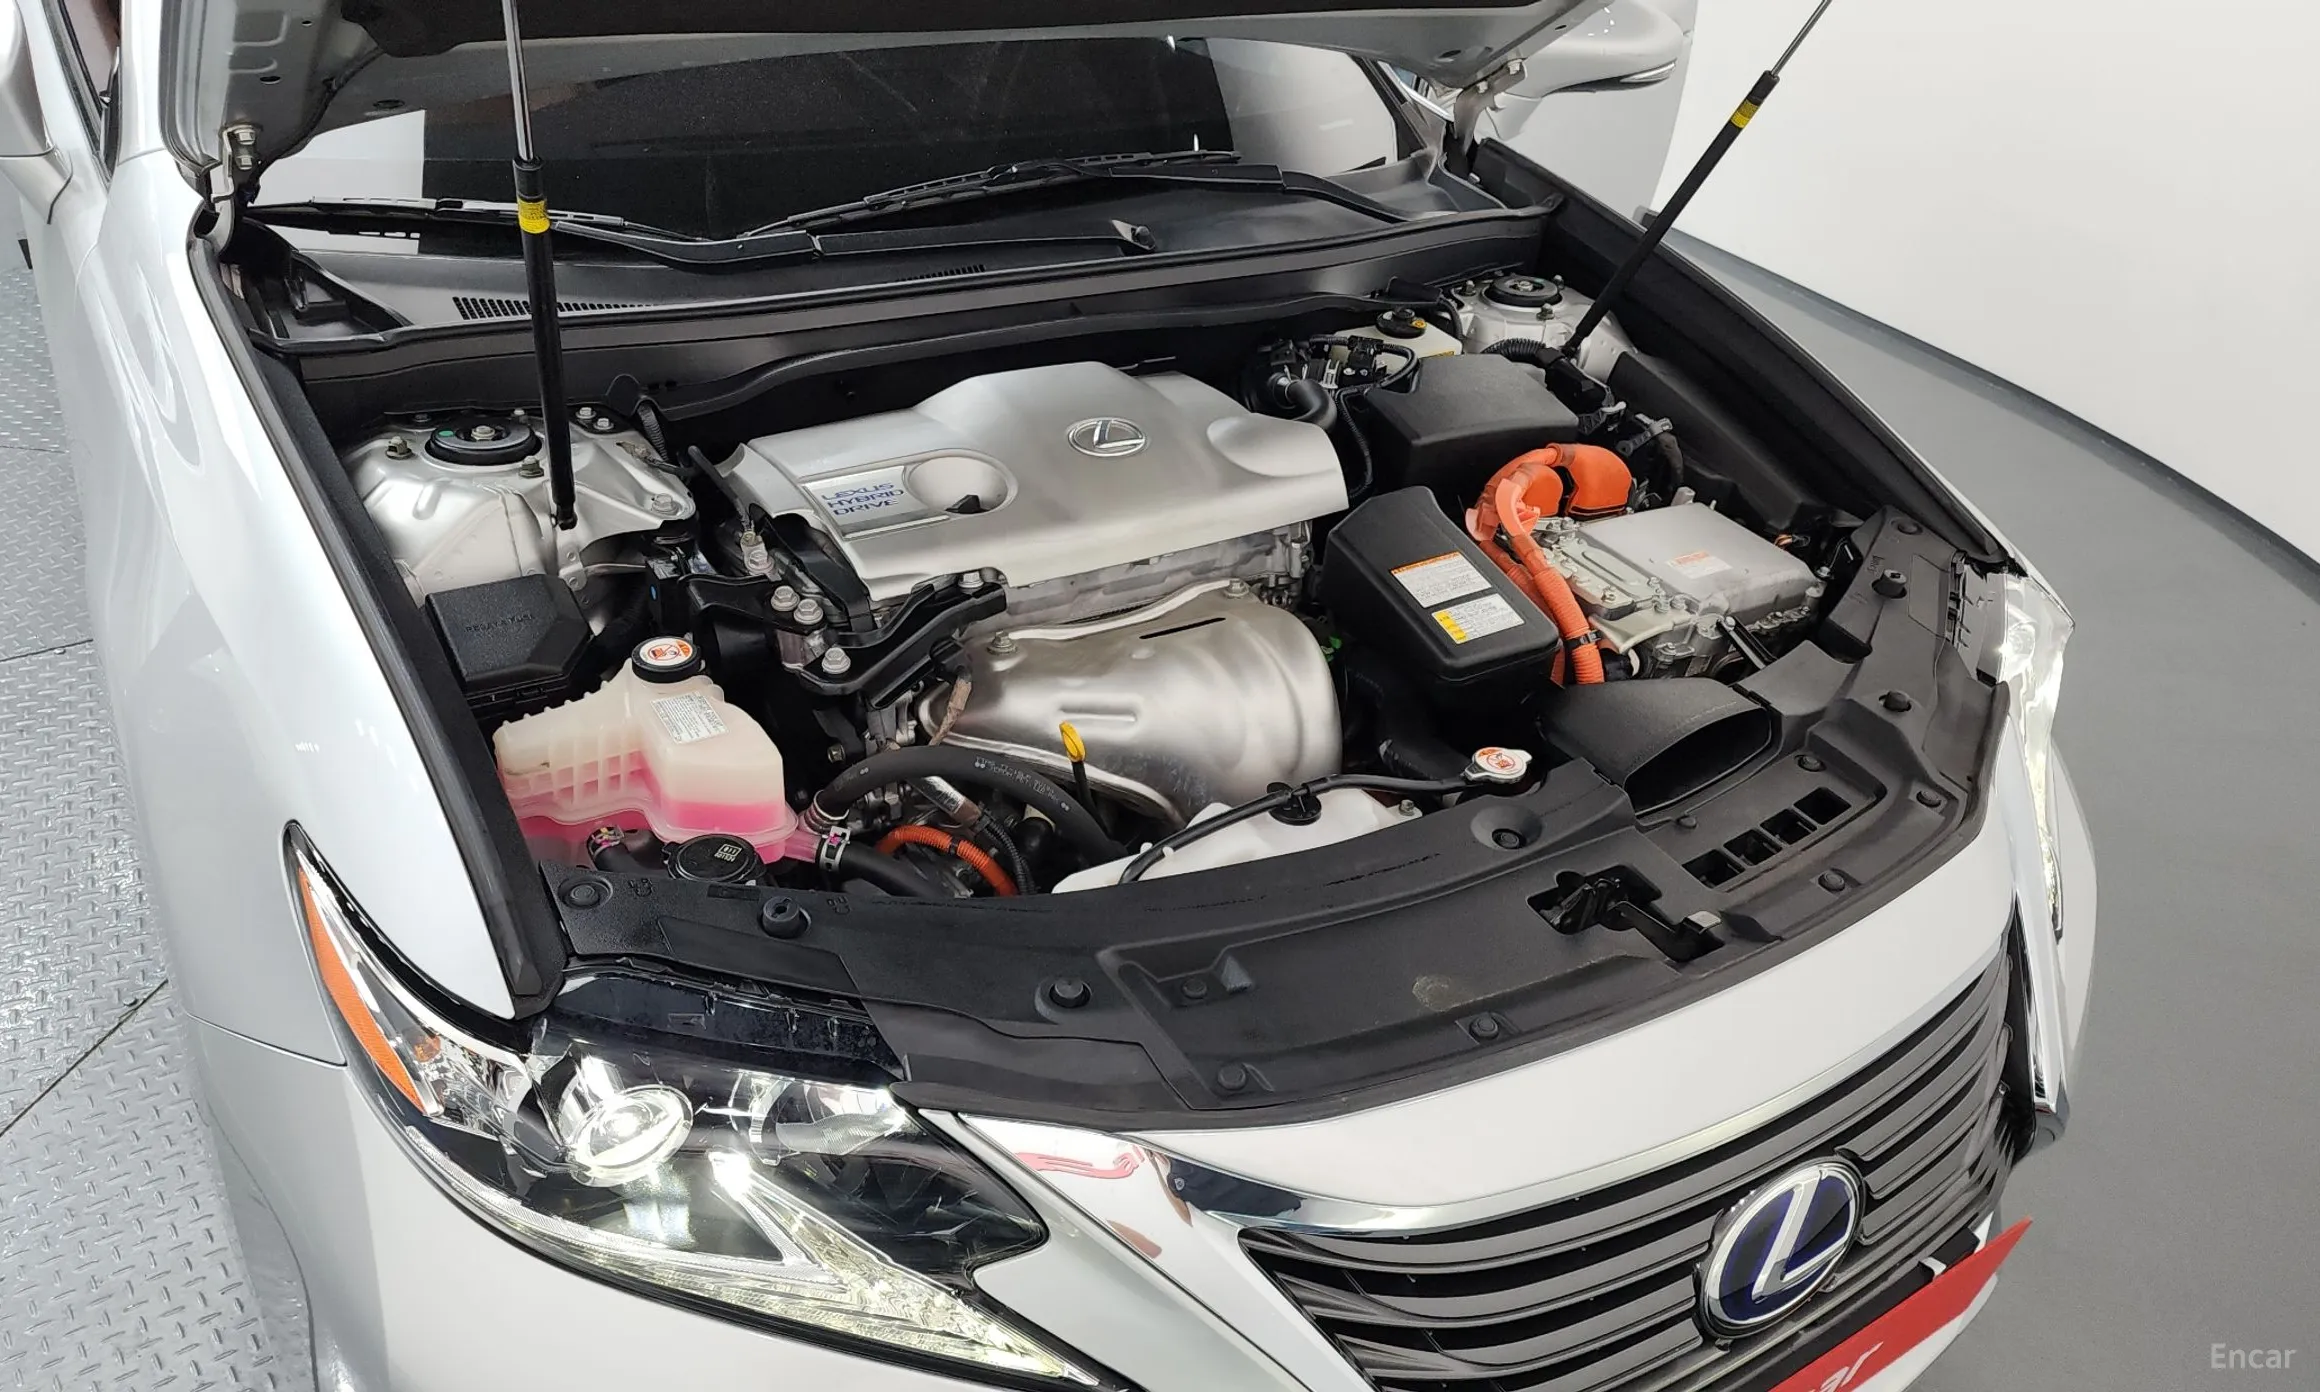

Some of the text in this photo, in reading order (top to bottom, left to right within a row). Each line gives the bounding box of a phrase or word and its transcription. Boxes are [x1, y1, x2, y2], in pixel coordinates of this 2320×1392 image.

[821, 482, 894, 500] LEXUS
[828, 489, 904, 508] HYBRID
[833, 500, 898, 515] DRIVE
